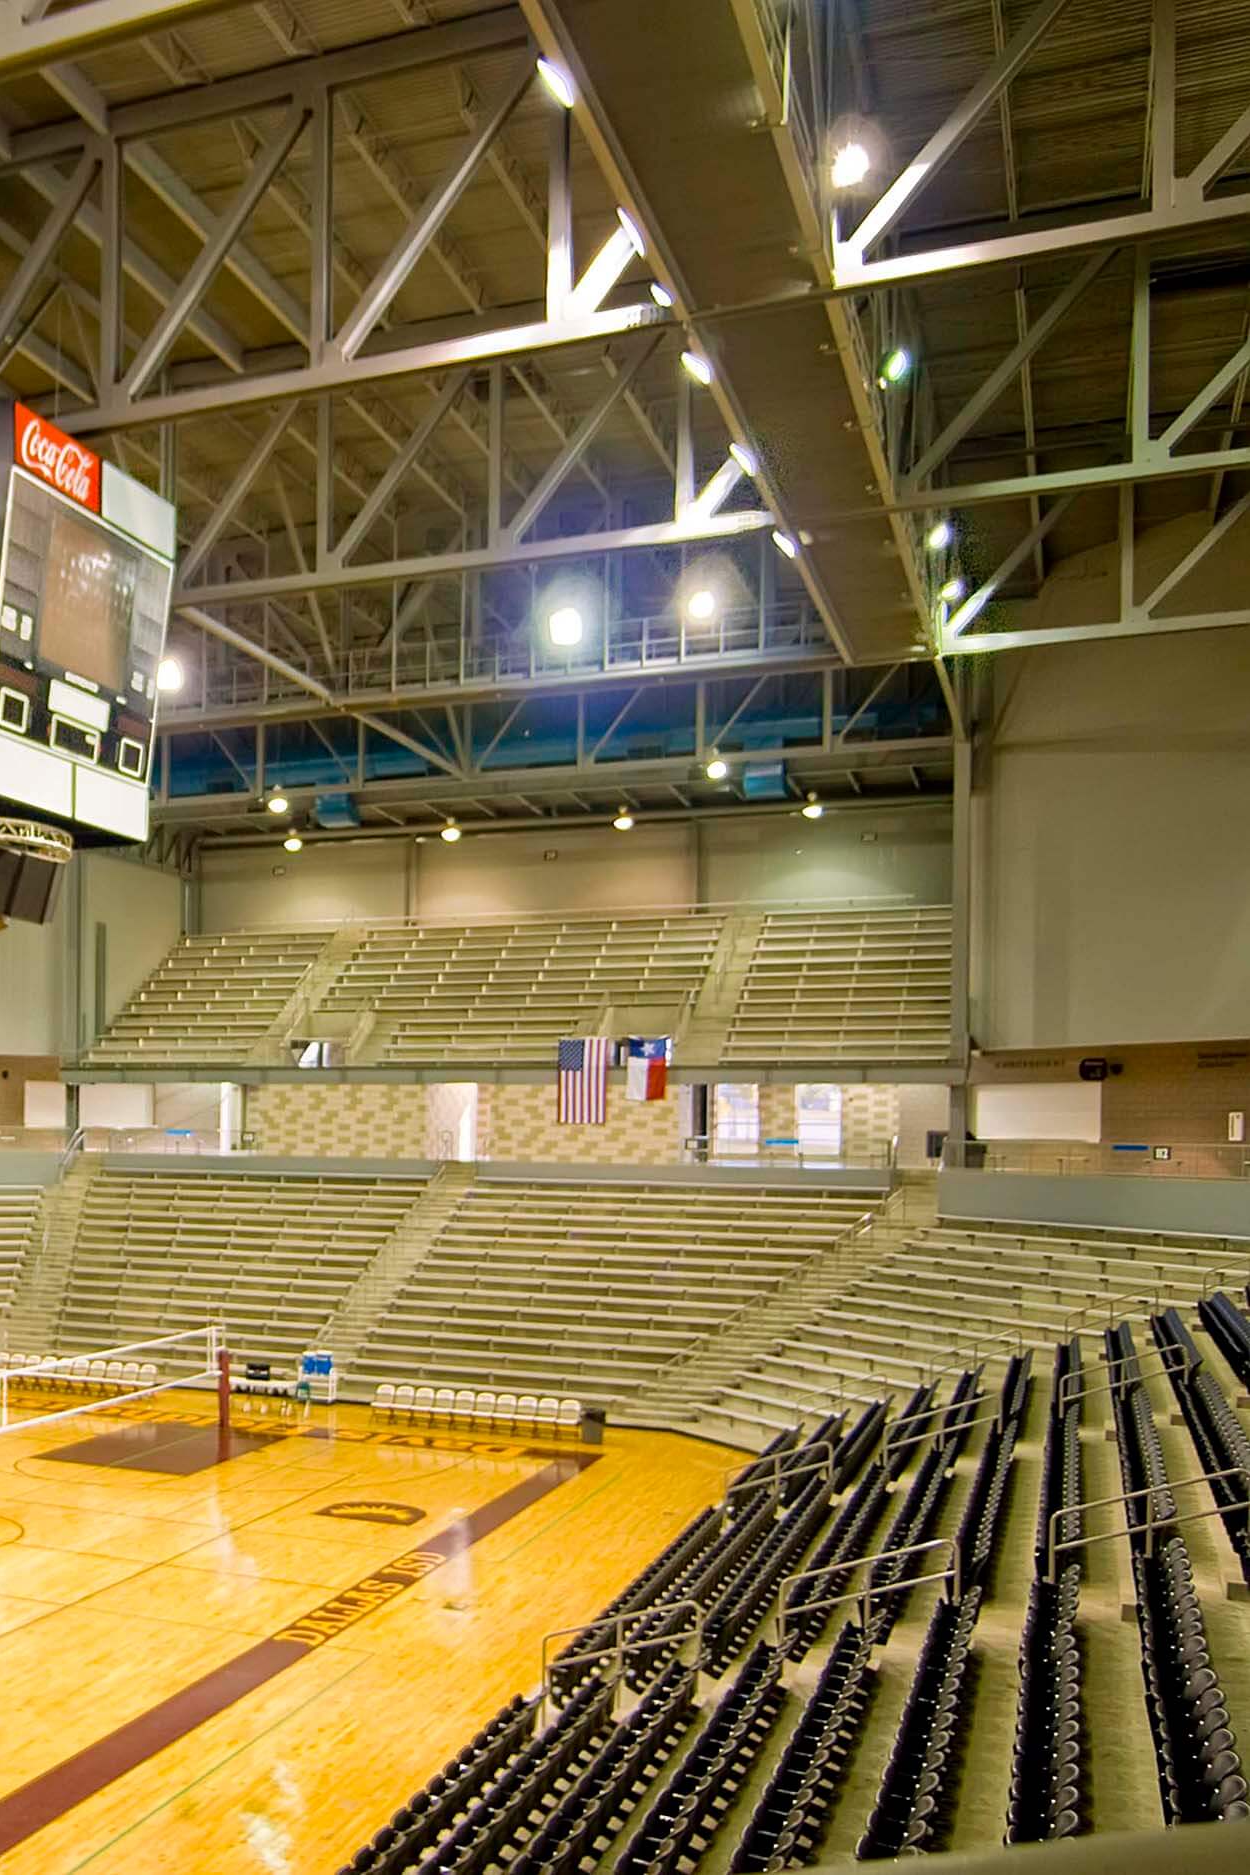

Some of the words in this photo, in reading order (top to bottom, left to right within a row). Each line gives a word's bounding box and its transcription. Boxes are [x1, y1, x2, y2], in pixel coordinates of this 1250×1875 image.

[21, 418, 93, 502] Coca-Cola
[273, 1579, 404, 1647] DALLAS
[381, 1551, 447, 1578] ISD
